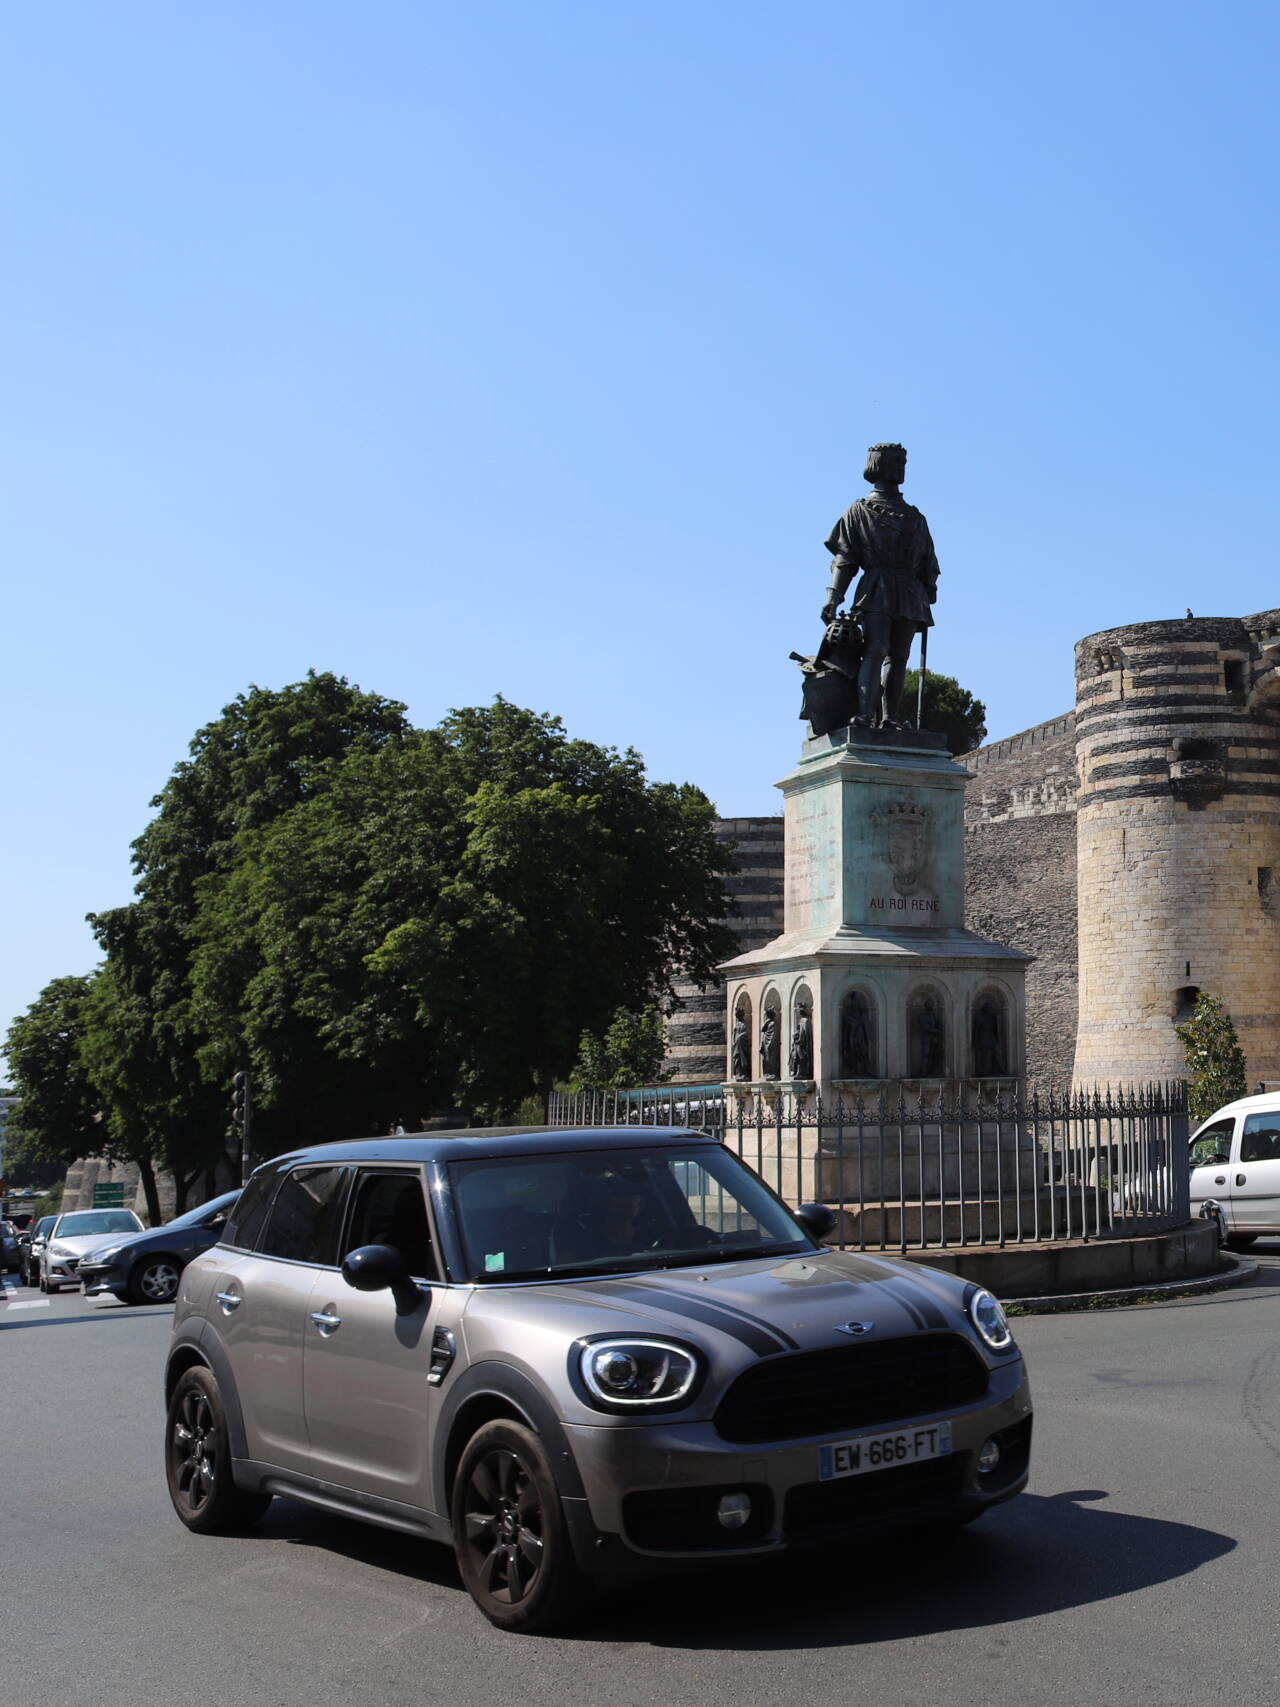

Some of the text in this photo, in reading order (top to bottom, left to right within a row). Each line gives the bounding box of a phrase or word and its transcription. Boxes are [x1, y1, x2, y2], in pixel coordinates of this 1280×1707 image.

[870, 895, 940, 912] AU ROI RENÉ
[834, 1429, 938, 1473] EW-666-FT
